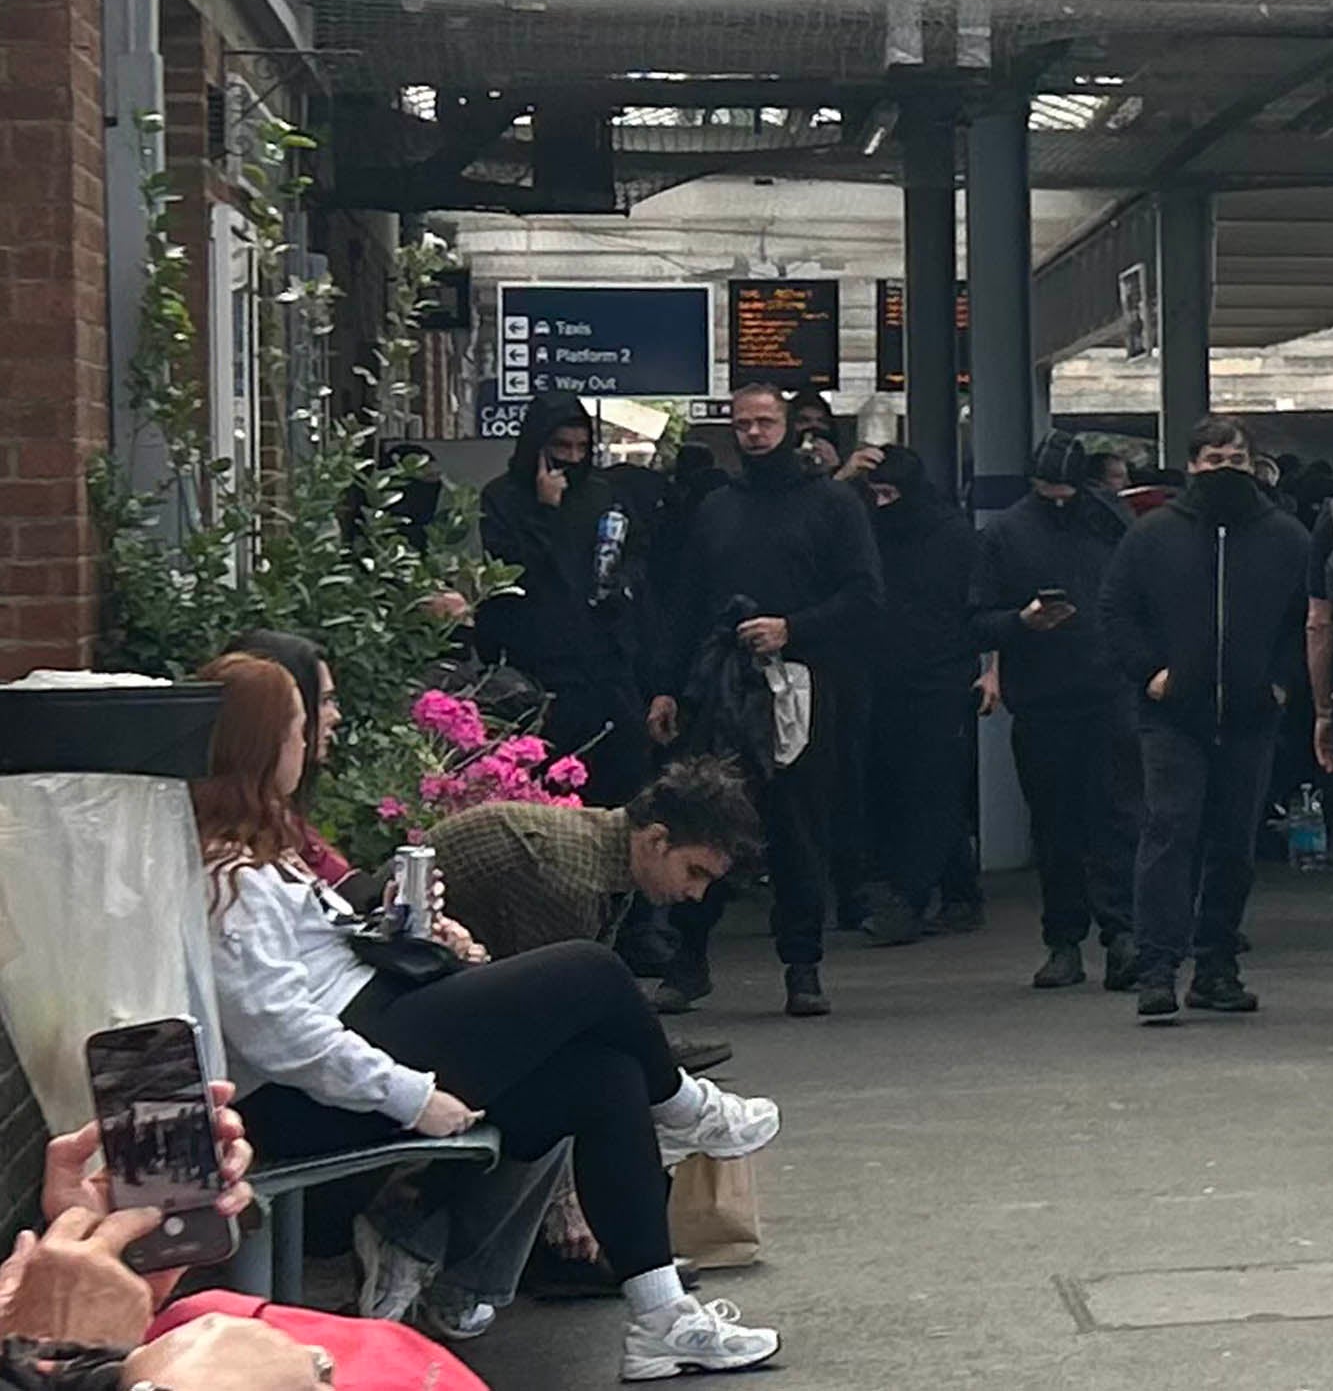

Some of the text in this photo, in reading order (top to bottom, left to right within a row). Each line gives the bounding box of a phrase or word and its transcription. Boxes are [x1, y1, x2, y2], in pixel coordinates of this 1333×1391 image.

[555, 320, 593, 336] Taxis
[555, 347, 632, 363] Platform 2
[554, 375, 617, 393] Way Out
